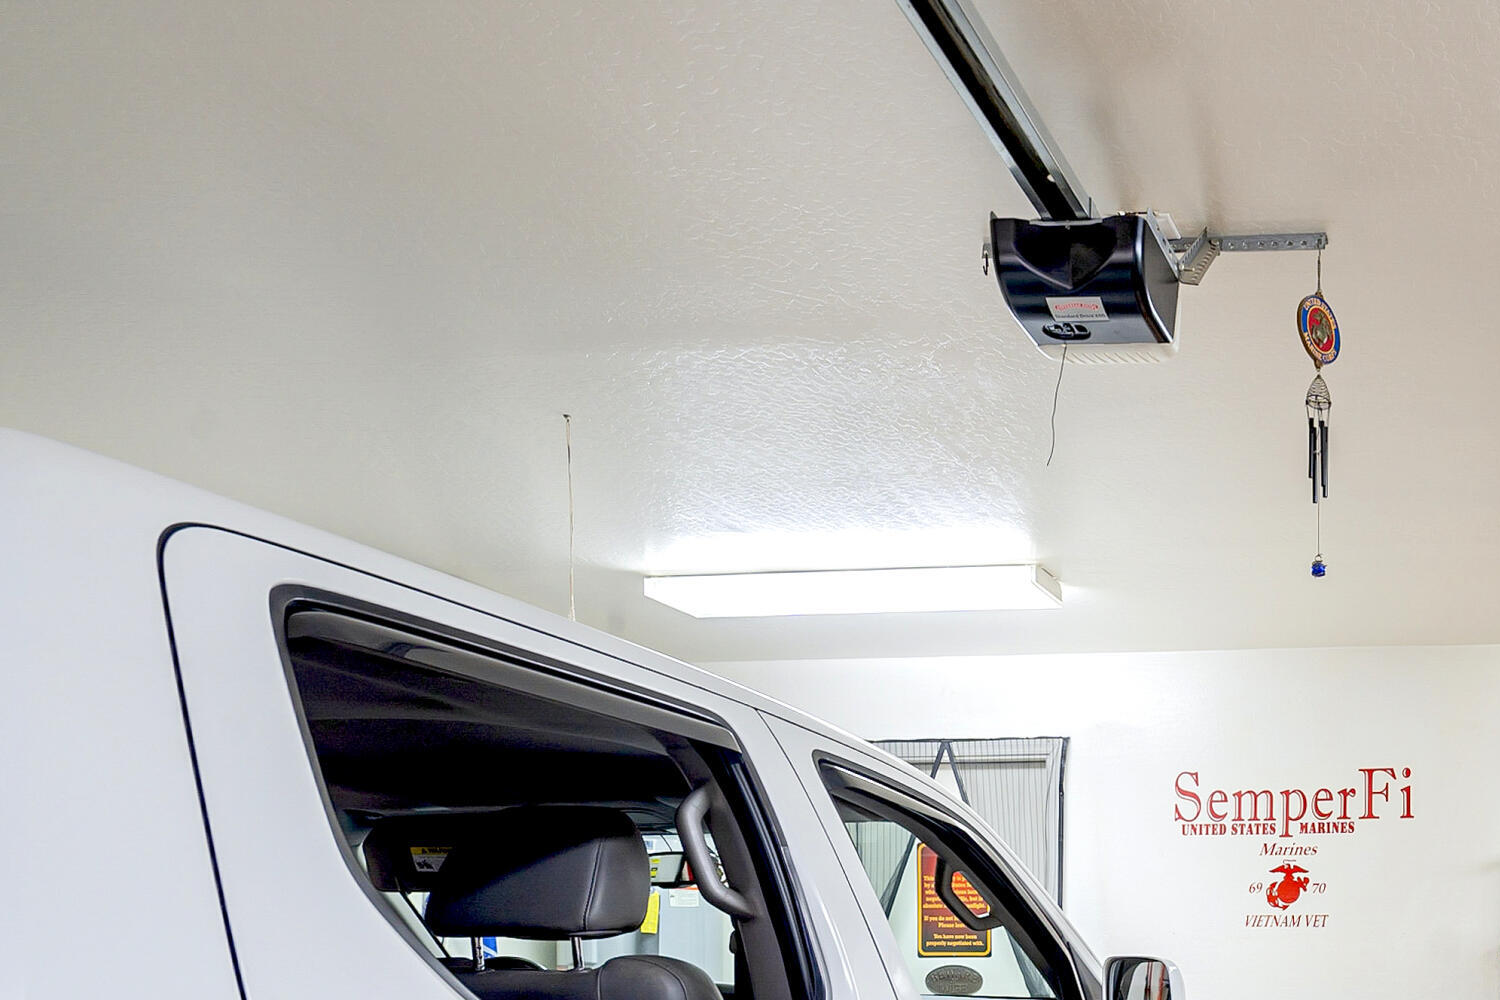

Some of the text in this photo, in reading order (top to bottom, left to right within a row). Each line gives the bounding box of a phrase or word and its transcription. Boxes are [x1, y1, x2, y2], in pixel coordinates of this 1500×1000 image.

[1181, 821, 1355, 836] UNITED STATES MARINES
[1258, 842, 1318, 856] Marines
[1248, 882, 1327, 894] 69 70
[1245, 914, 1329, 928] VIETNAM VET
